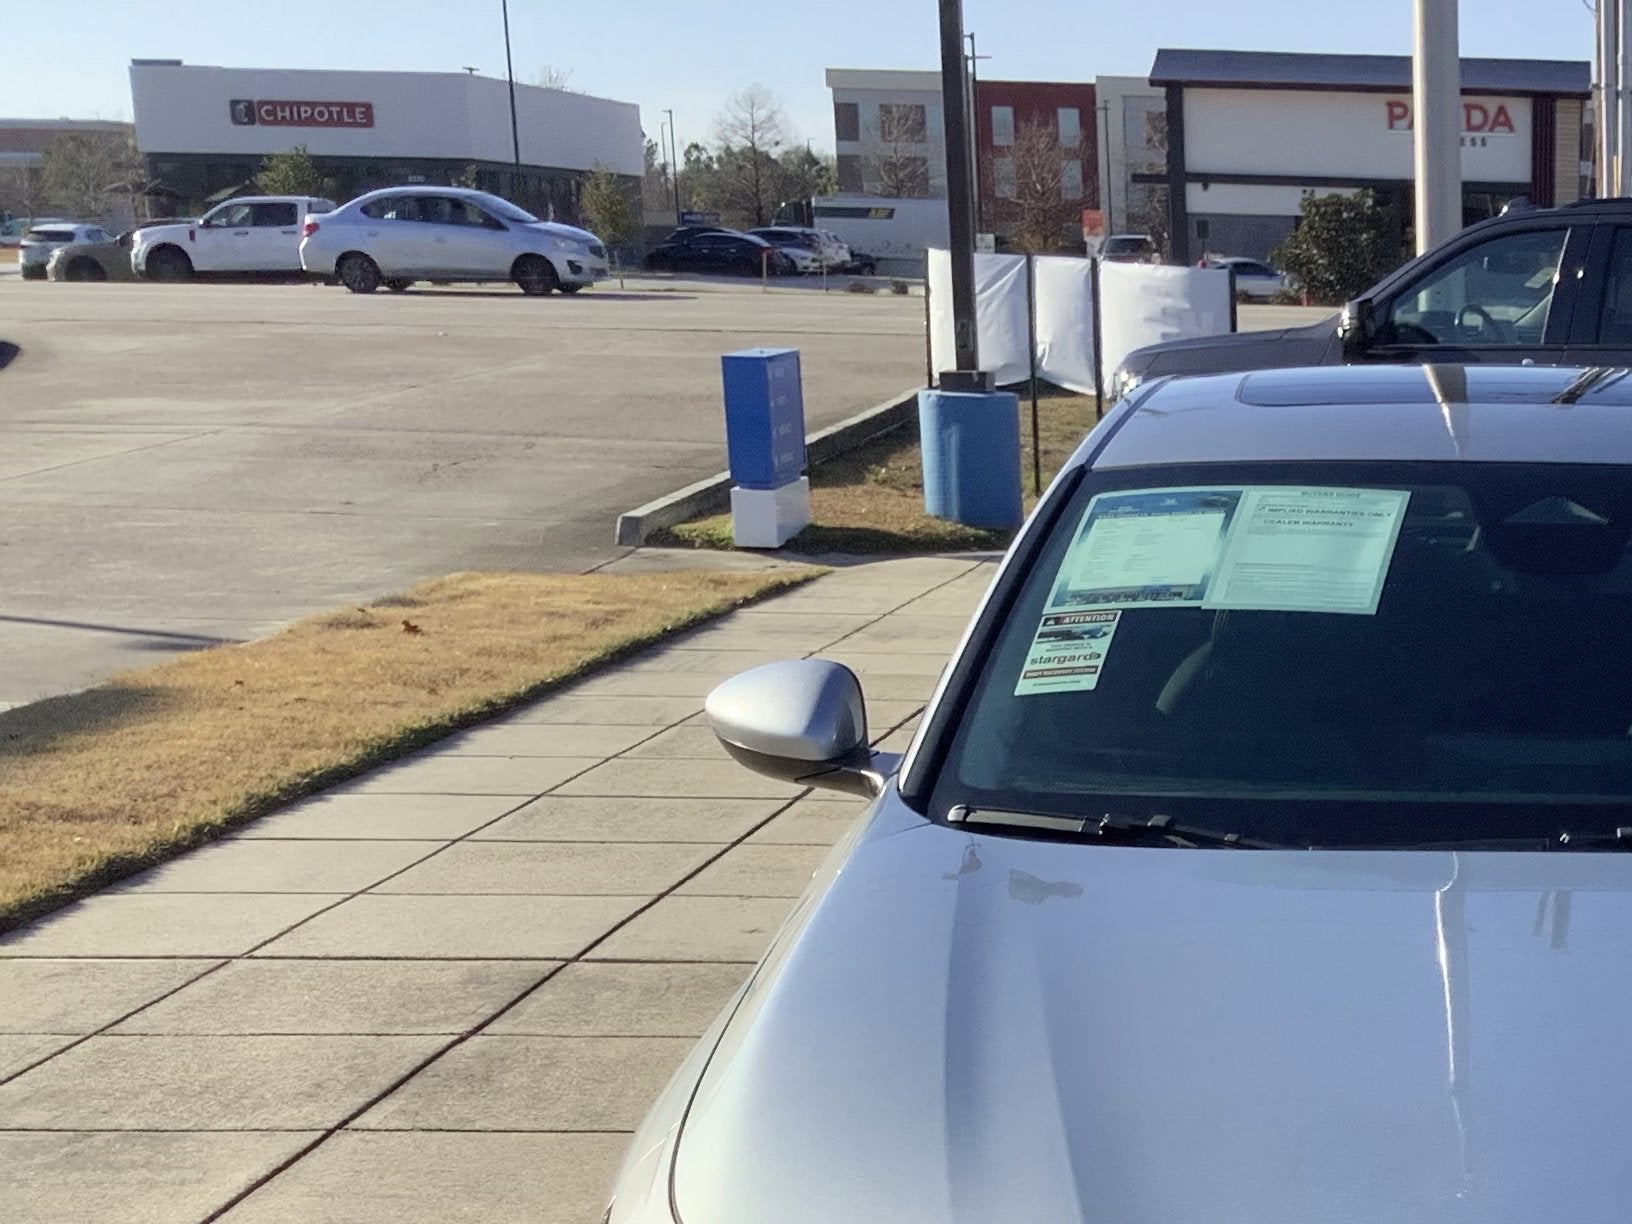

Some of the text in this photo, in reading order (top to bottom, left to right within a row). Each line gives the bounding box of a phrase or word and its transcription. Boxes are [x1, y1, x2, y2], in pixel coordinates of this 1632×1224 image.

[260, 105, 367, 123] CHIPOTLE
[1385, 101, 1515, 133] PDA
[1267, 507, 1304, 515] IMPLIED
[1305, 508, 1365, 517] WARRANTIES
[1302, 519, 1354, 528] WARRANTY
[1063, 613, 1116, 624] ATTENTION
